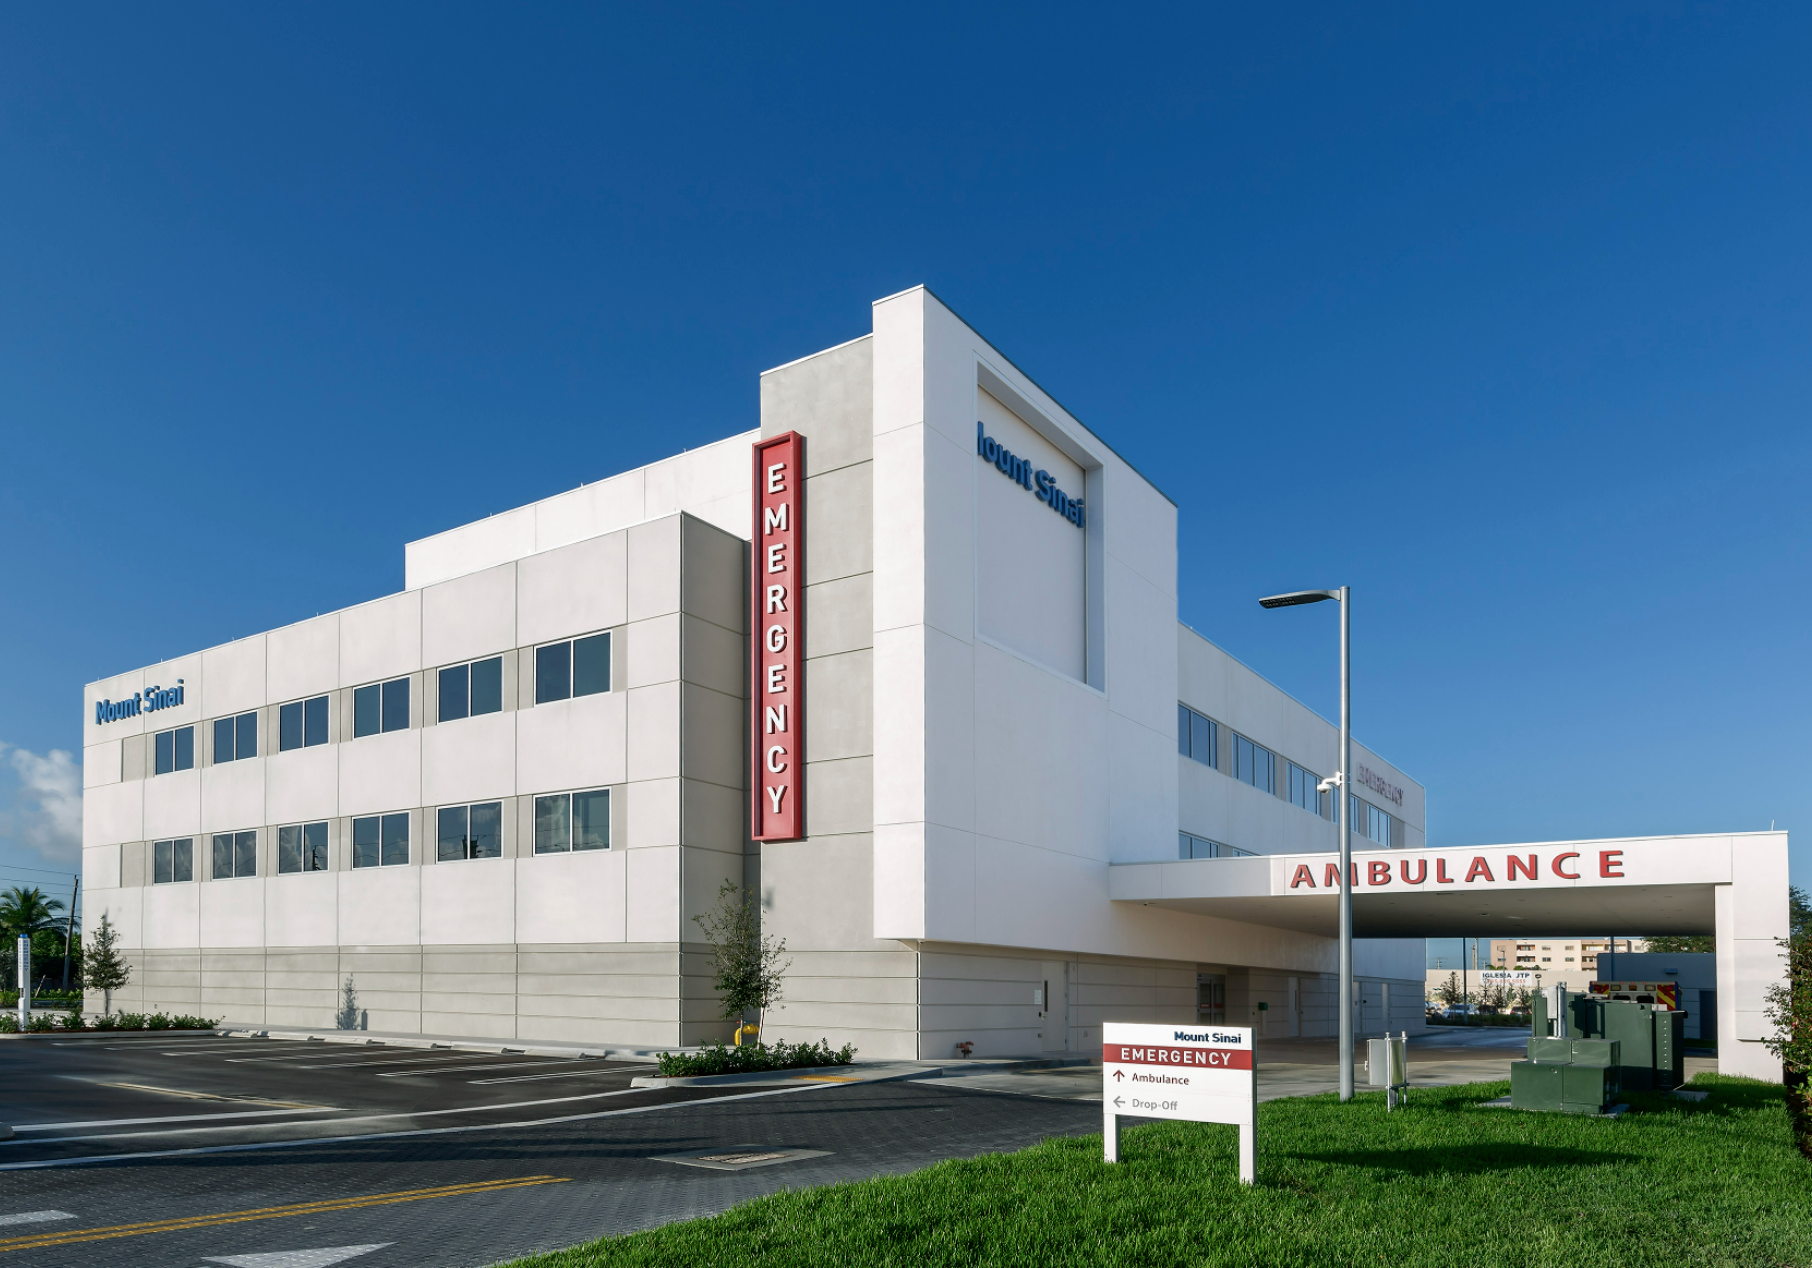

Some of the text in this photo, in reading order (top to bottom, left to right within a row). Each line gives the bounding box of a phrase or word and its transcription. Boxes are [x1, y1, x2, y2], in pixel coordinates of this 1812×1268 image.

[1035, 469, 1085, 528] Sinai
[764, 462, 789, 814] EMERGENCY
[95, 678, 184, 725] Mount Sinai
[1356, 762, 1404, 806] EMERGENCY
[1290, 850, 1625, 889] AMBULANCE
[1121, 1047, 1232, 1066] EMERGENCY
[1174, 1031, 1242, 1044] Mount Sinai
[1132, 1072, 1190, 1086] Ambulance
[1132, 1098, 1178, 1111] Drop-Off
